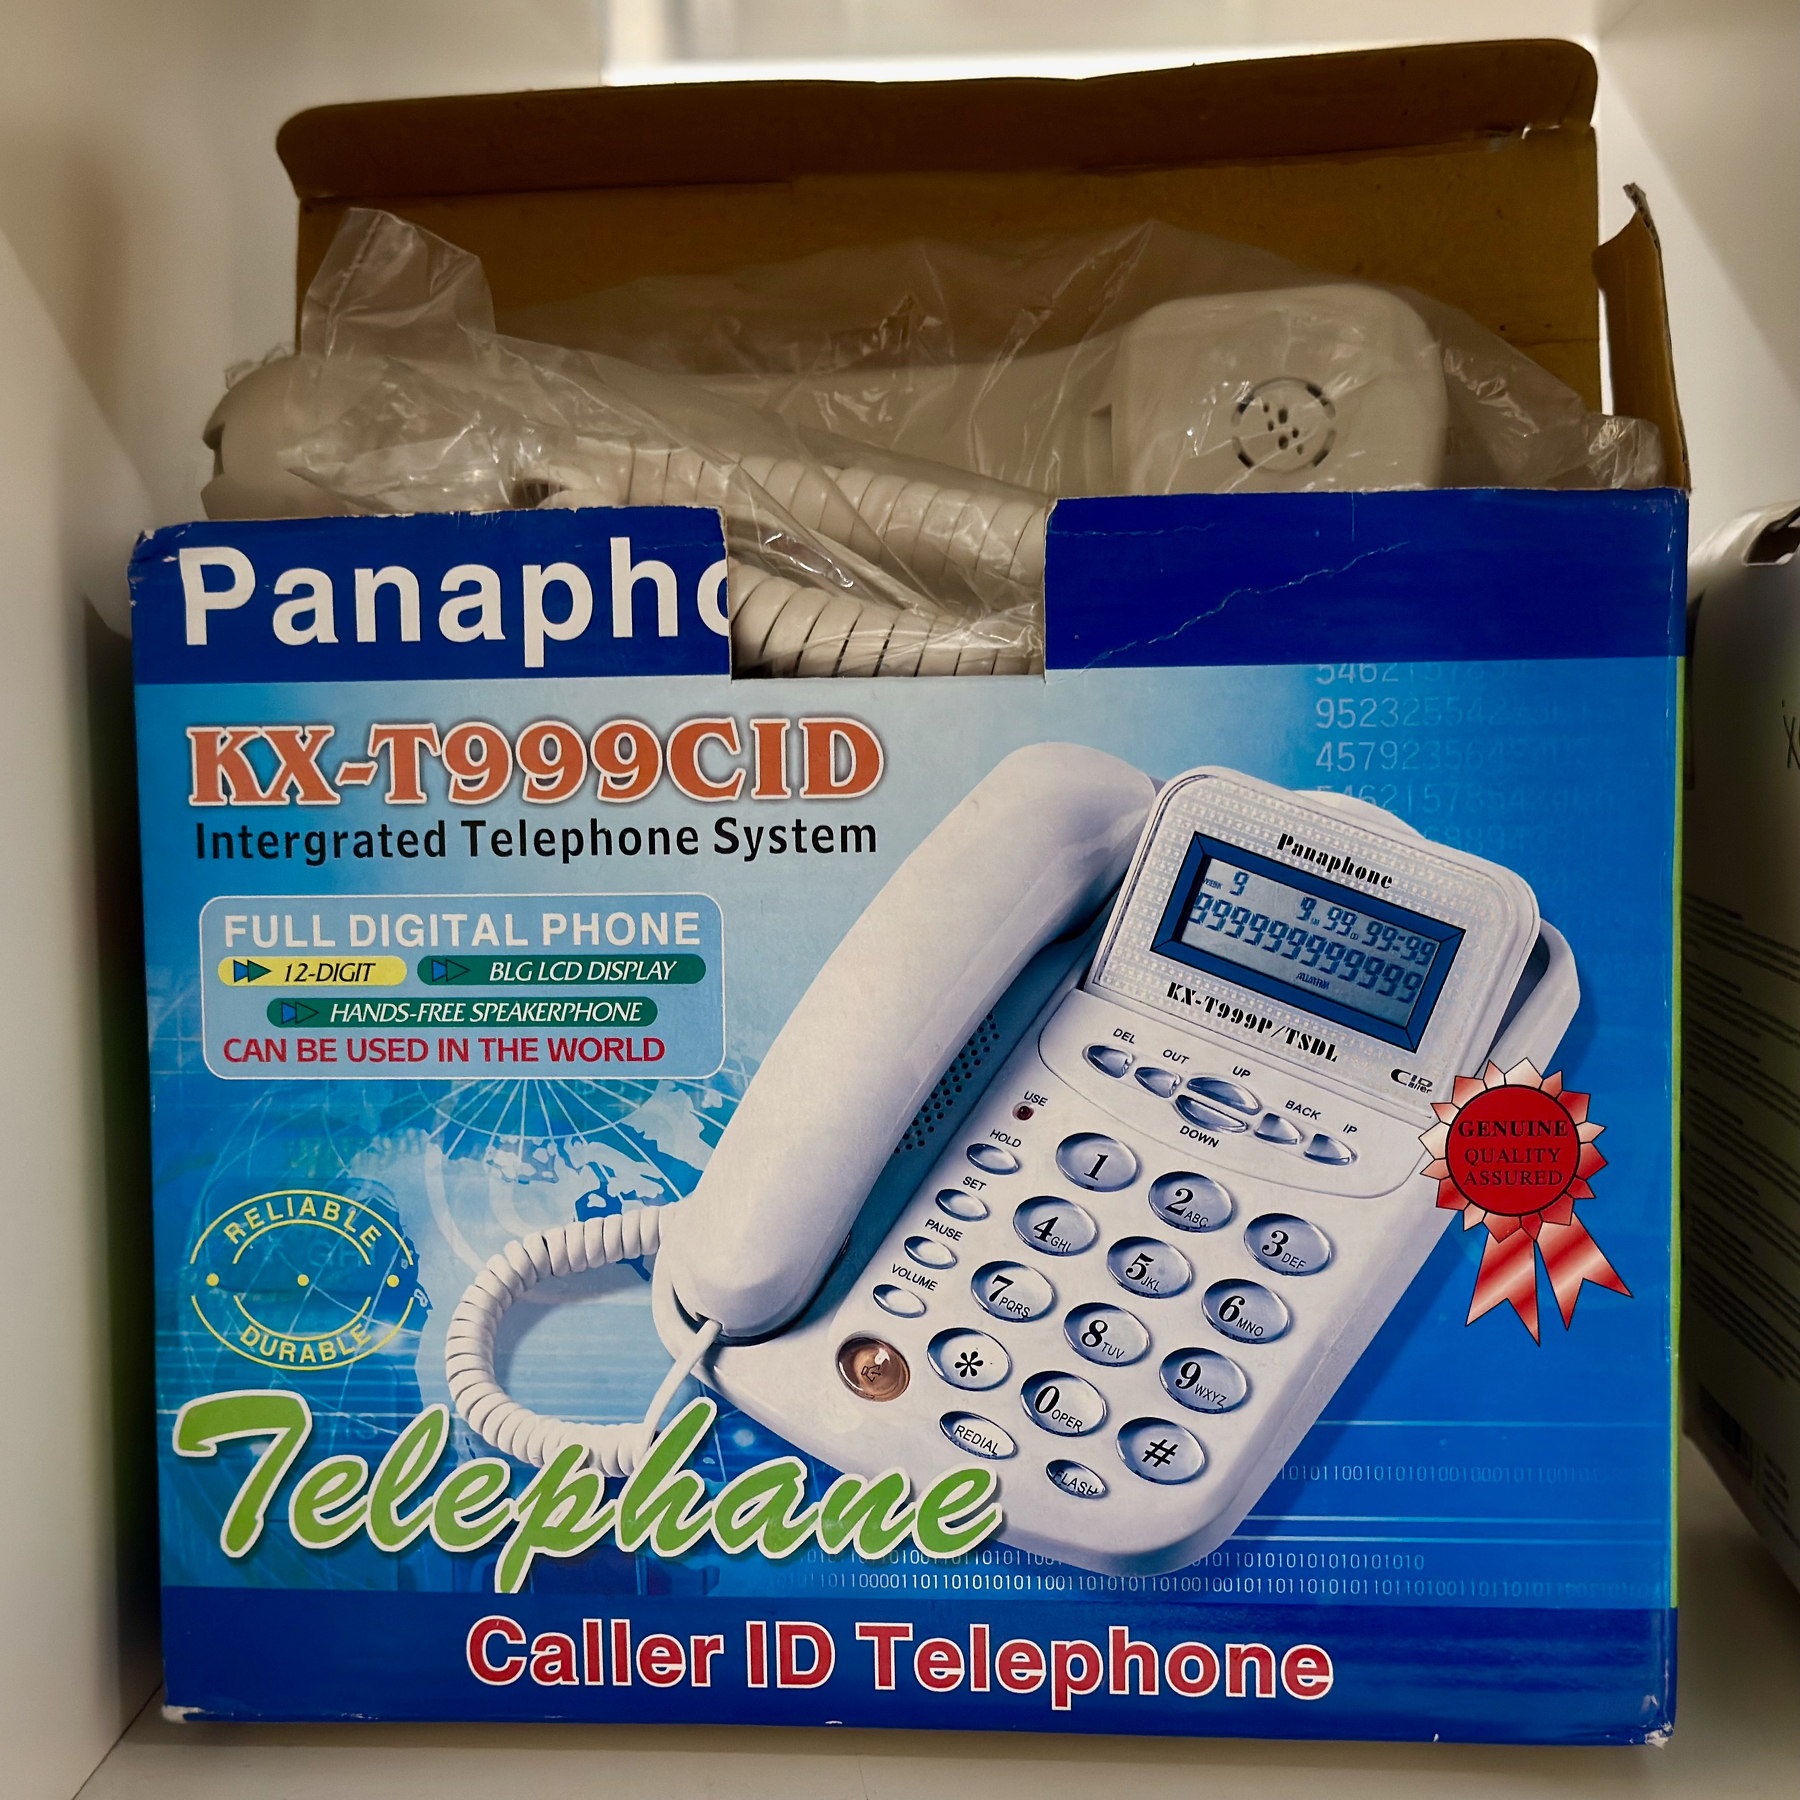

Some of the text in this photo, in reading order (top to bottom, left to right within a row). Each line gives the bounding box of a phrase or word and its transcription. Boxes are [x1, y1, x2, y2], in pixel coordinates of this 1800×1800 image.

[186, 717, 885, 807] KX-T999CID
[196, 817, 876, 866] Intergrated Telephone System
[1276, 832, 1393, 889] Panaphone
[224, 911, 699, 948] FULL DIGITAL PHONE
[284, 961, 376, 983] 12-DIGIT
[489, 961, 677, 982] BLG LCD DISPLAY
[329, 1002, 642, 1023] HANDS-FREE SPEAKERPHONE
[1166, 982, 1338, 1062] KX-T999P/TSDL
[223, 1037, 666, 1063] CAN BE USED IN THE WORLD
[1113, 1028, 1136, 1044] DEL
[1162, 1049, 1190, 1065] OUT
[1232, 1065, 1251, 1079] UP
[1023, 1090, 1048, 1107] USE
[1285, 1100, 1321, 1120] BACK
[989, 1129, 1022, 1148] HOLD
[1179, 1125, 1219, 1148] DOWN
[1342, 1123, 1358, 1134] IP
[1458, 1120, 1569, 1138] GENUINE
[1083, 1153, 1109, 1181] 1
[1464, 1148, 1561, 1166] QUALITY
[962, 1176, 987, 1192] SET
[1463, 1170, 1563, 1186] ASSURED
[1164, 1187, 1209, 1229] 2 ABC
[223, 1197, 382, 1249] RELIABLE
[925, 1218, 963, 1242] PAUSE
[1033, 1216, 1072, 1252] 4 GHI
[1261, 1230, 1306, 1270] 3 DEF
[892, 1264, 938, 1291] VOLUME
[1125, 1252, 1160, 1292] 5 JKL
[988, 1274, 1031, 1319] 7 PQRS
[1218, 1295, 1264, 1337] 6 MNO
[240, 1323, 372, 1364] DURABLE
[1081, 1319, 1125, 1359] 8 TUV
[1175, 1361, 1228, 1408] 9 WXYZ
[1034, 1385, 1083, 1432] 0 OPER
[954, 1424, 999, 1455] REDIAL
[466, 1615, 1334, 1711] Caller ID Telephone
